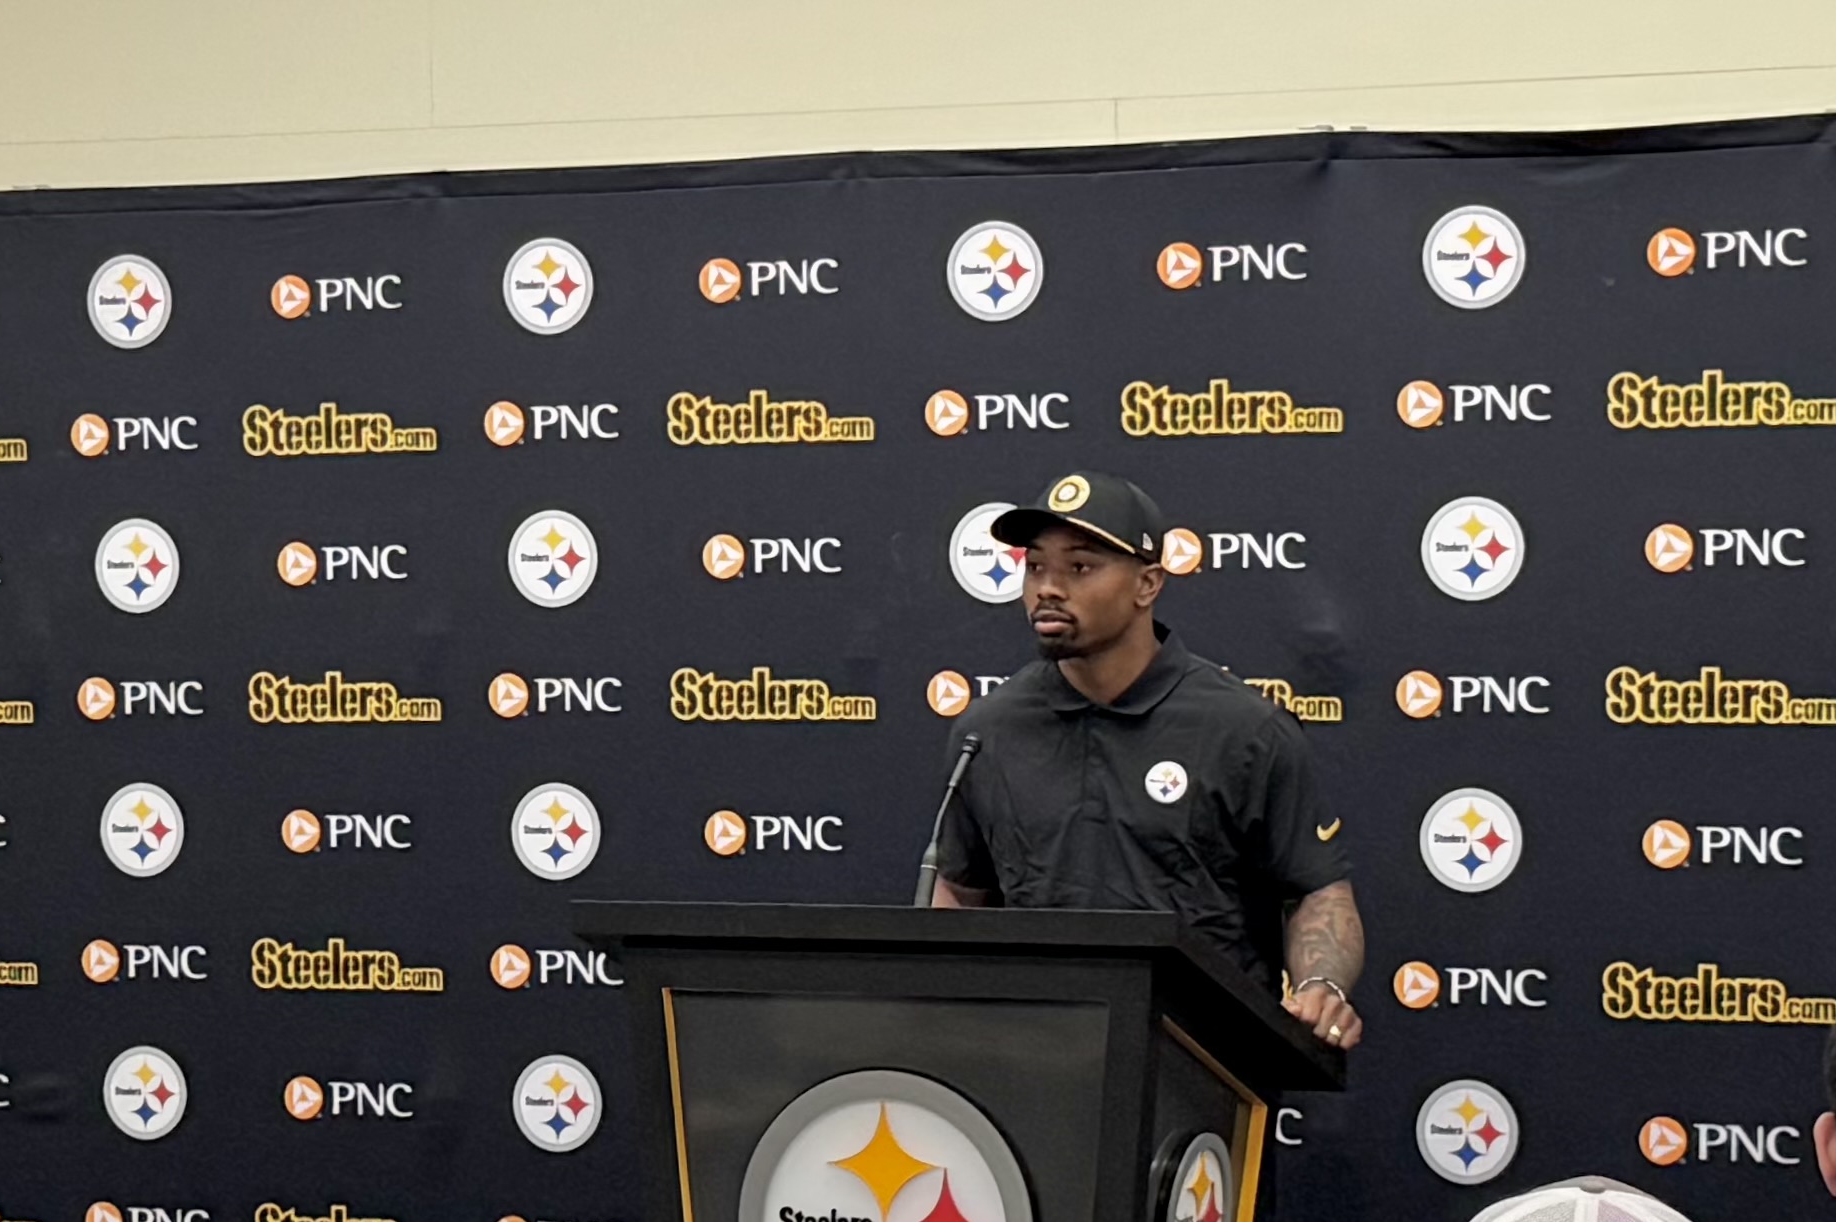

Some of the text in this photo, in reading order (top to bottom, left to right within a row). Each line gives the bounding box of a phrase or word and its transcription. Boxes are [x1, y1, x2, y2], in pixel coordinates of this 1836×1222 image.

[1208, 243, 1307, 281] PNC
[1436, 249, 1472, 261] Steelers
[1702, 228, 1807, 268] PNC
[514, 279, 546, 290] Steelers
[748, 258, 838, 296] PNC
[960, 264, 993, 276] Steelers
[317, 275, 402, 312] PNC
[667, 390, 876, 446] Steelers.com
[975, 393, 1069, 429] PNC
[1122, 379, 1345, 437] Steelers.com
[1450, 384, 1551, 421] PNC
[114, 416, 198, 450] PNC
[243, 405, 438, 457] Steelers.com
[531, 404, 619, 439] PNC
[322, 545, 407, 580] PNC
[520, 552, 551, 563] Steelers
[751, 538, 841, 573] PNC
[962, 546, 993, 557] Steelers
[1209, 532, 1306, 569] PNC
[1435, 541, 1471, 553] Steelers
[1700, 528, 1805, 566] PNC
[121, 681, 203, 714] PNC
[249, 673, 443, 724] Steelers.com
[535, 677, 621, 712] PNC
[672, 670, 877, 722] Steelers.com
[1449, 676, 1550, 713] PNC
[326, 815, 411, 848] PNC
[523, 824, 554, 835] Steelers
[752, 816, 842, 851] PNC
[1433, 833, 1469, 844] Steelers
[1698, 827, 1802, 864] PNC
[125, 945, 207, 979] PNC
[252, 939, 444, 992] Steelers.com
[537, 950, 623, 985] PNC
[1446, 968, 1546, 1006] PNC
[330, 1082, 412, 1117] PNC
[525, 1095, 556, 1107] Steelers
[1430, 1123, 1465, 1136] Steelers
[1695, 1124, 1799, 1163] PNC
